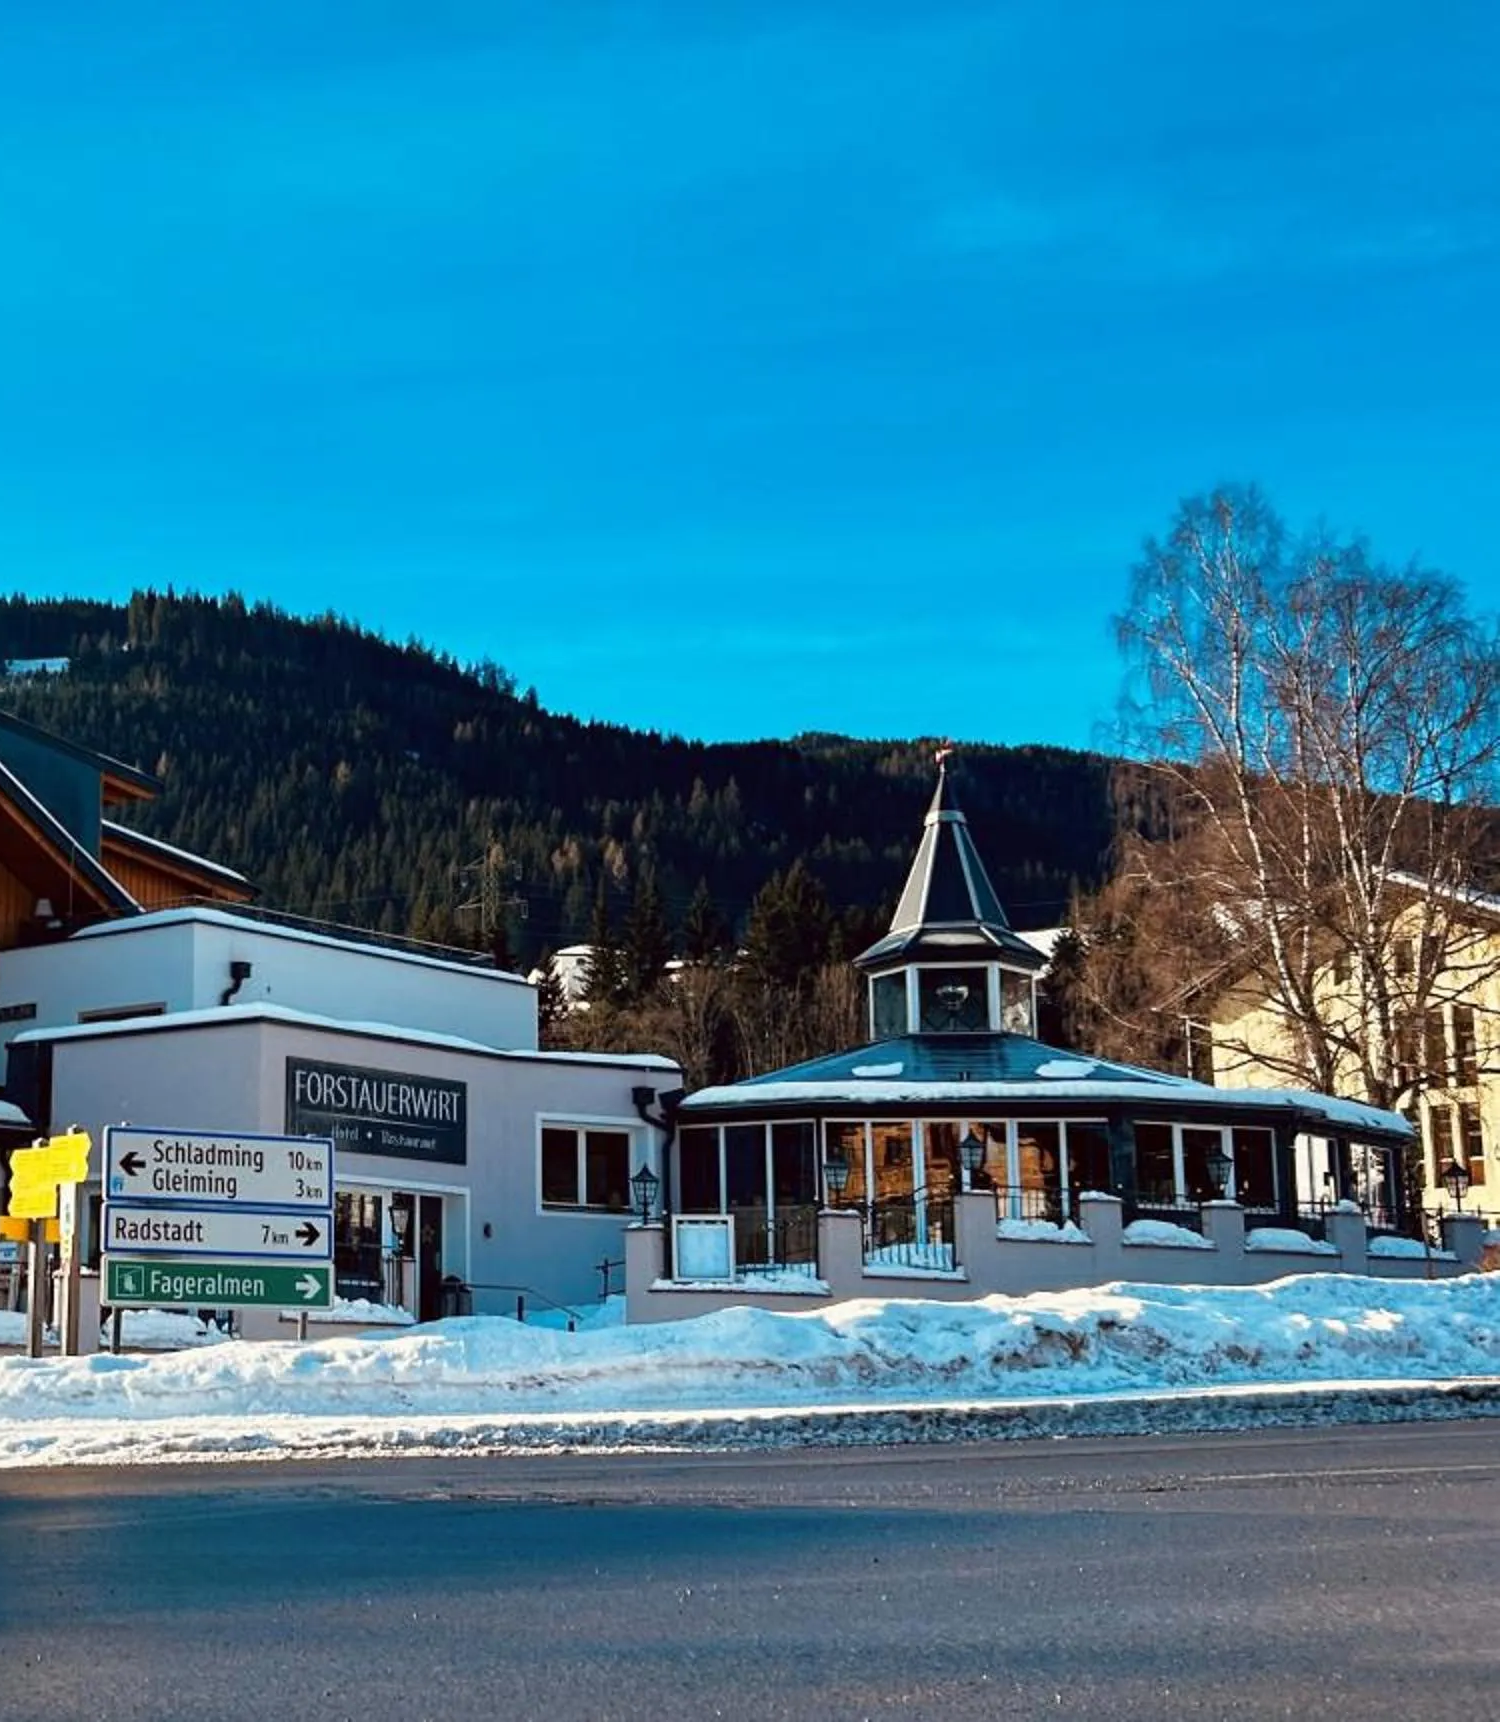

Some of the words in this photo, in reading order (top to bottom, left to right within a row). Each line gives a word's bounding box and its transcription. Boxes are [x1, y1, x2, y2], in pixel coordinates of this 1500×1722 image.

[153, 1140, 264, 1172] Schladming
[153, 1168, 237, 1198] Gleiming
[115, 1217, 204, 1243] Radstadt
[151, 1271, 265, 1297] Fageralmen
